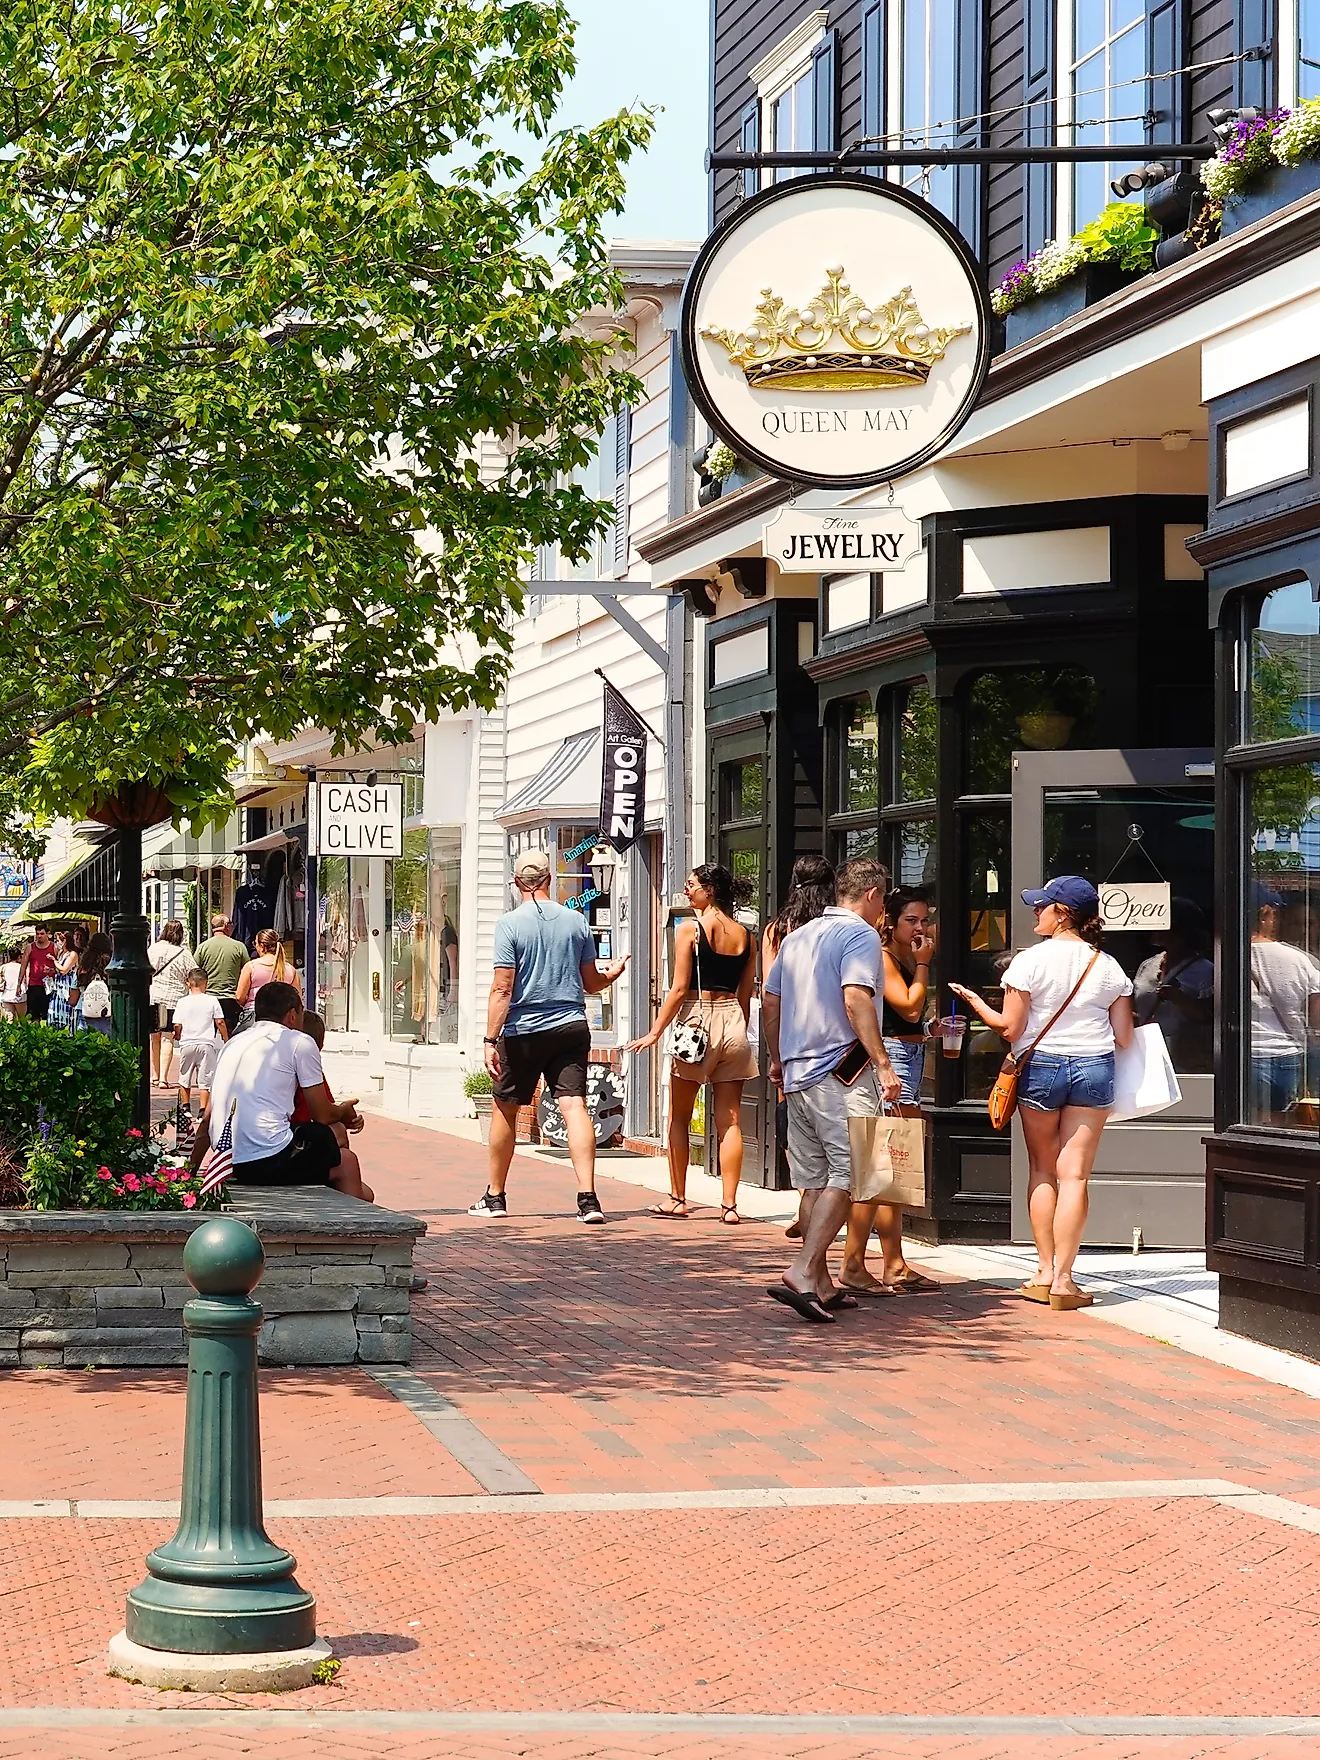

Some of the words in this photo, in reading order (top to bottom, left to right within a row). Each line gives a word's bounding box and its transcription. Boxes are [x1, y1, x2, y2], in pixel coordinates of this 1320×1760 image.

[761, 410, 848, 438] QUEEN
[862, 409, 913, 432] MAY
[821, 517, 859, 530] Fine
[782, 533, 905, 562] JEWELRY
[607, 734, 620, 743] Art
[328, 788, 388, 813] CASH
[609, 746, 639, 839] OPEN
[328, 814, 341, 822] AND
[328, 824, 394, 849] CLIVE
[563, 835, 598, 863] Amazing
[243, 898, 255, 908] CAPE
[1101, 888, 1168, 926] Open
